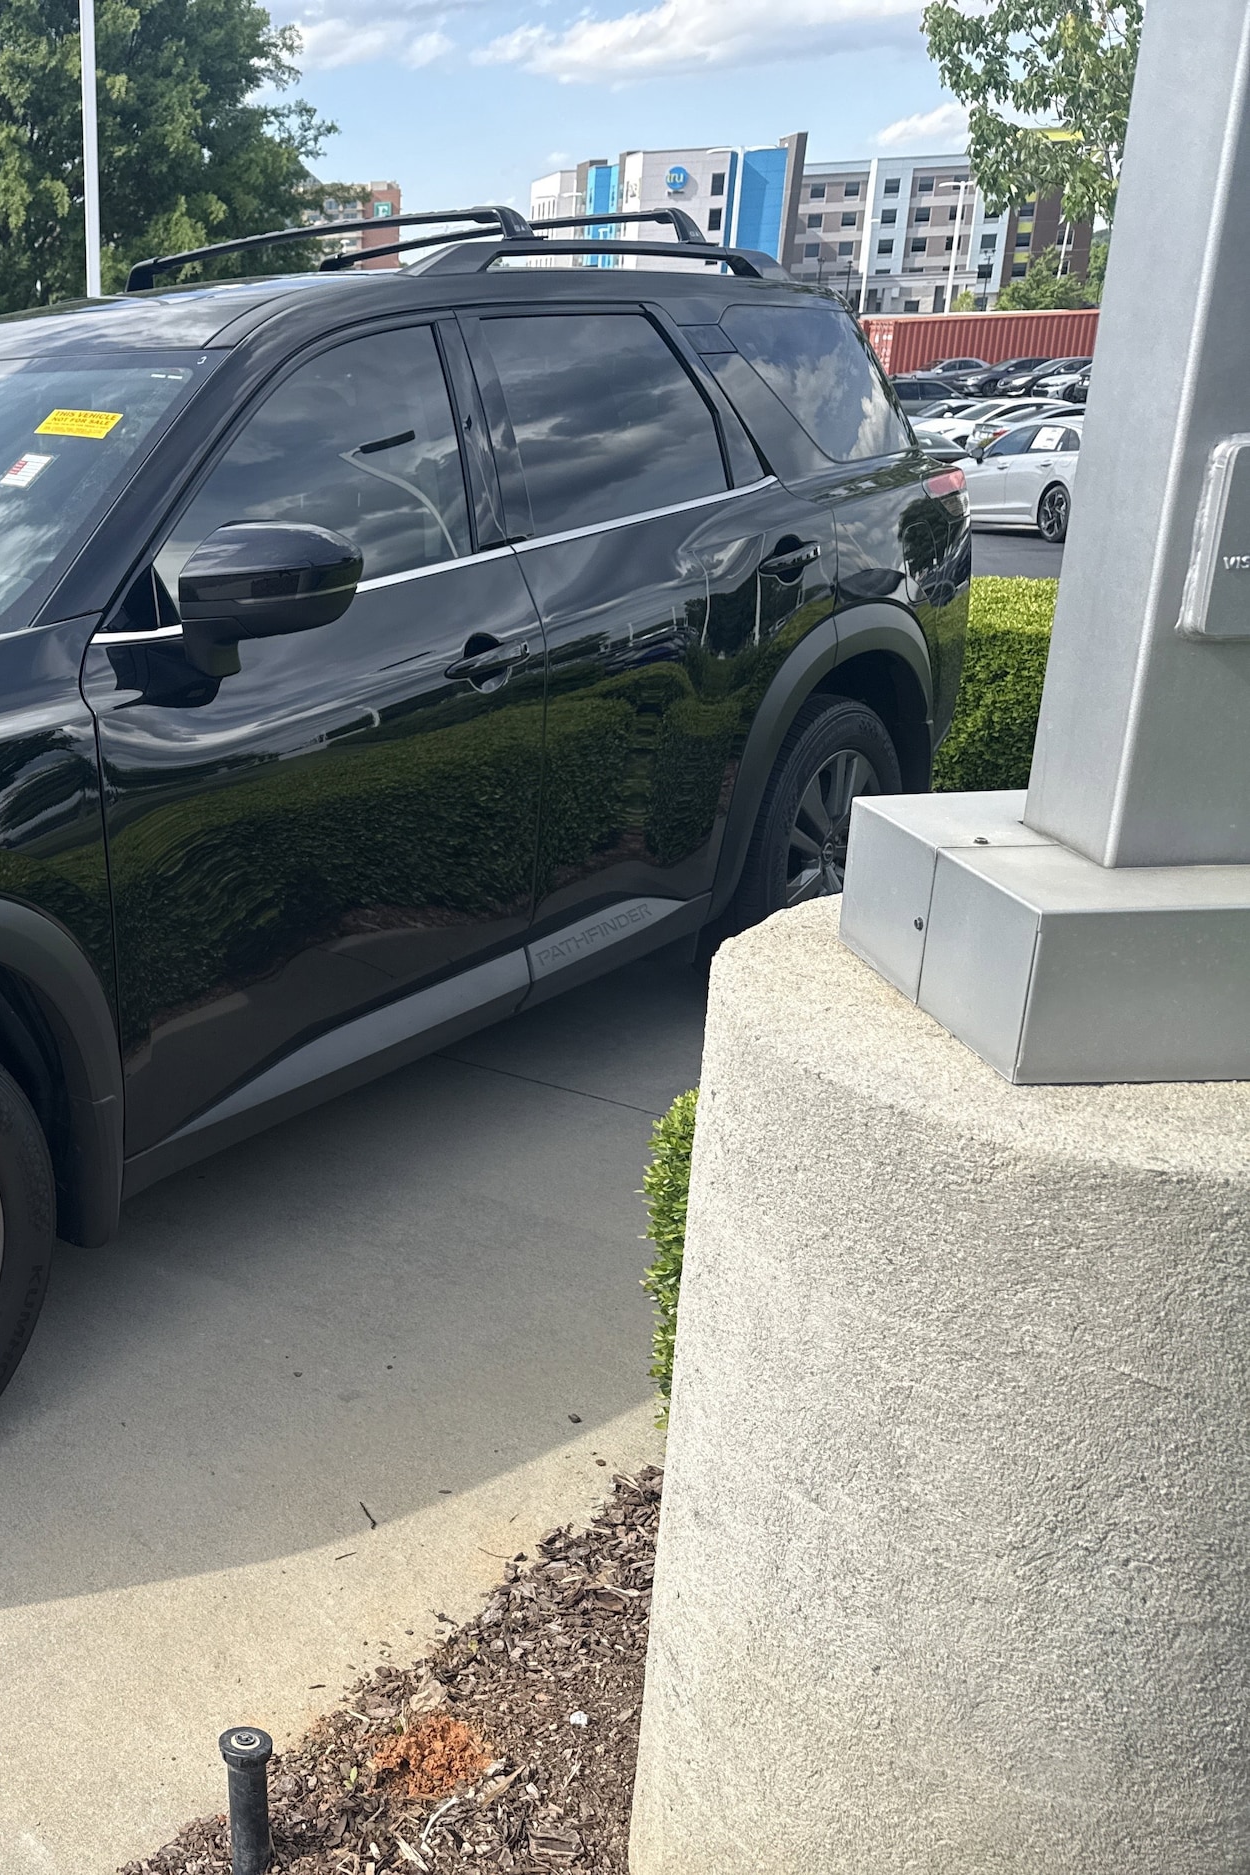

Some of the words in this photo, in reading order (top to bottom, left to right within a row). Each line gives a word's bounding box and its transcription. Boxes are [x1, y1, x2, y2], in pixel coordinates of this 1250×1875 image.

[667, 172, 683, 183] tru
[78, 412, 116, 420] VEHICLE
[534, 903, 653, 967] PATHFINDER
